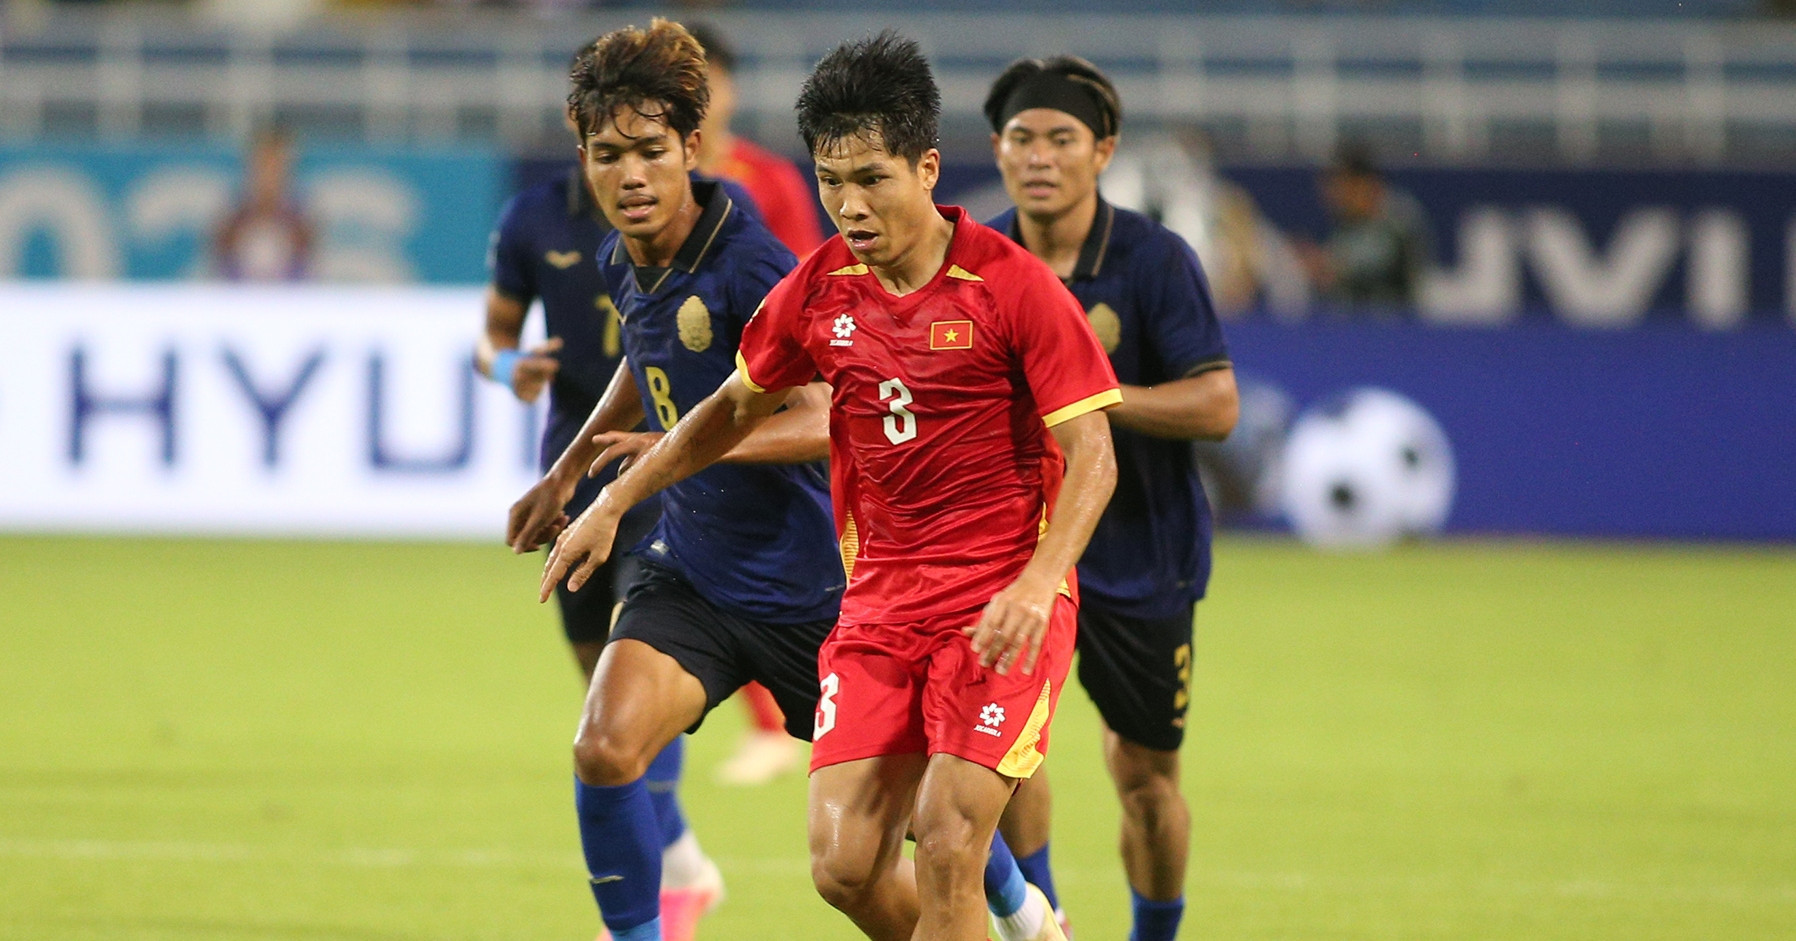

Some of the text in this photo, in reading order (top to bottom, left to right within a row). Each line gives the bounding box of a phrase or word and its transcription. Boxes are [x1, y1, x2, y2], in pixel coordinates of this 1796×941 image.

[645, 366, 679, 432] 8
[878, 377, 917, 446] 3
[813, 672, 840, 741] 3
